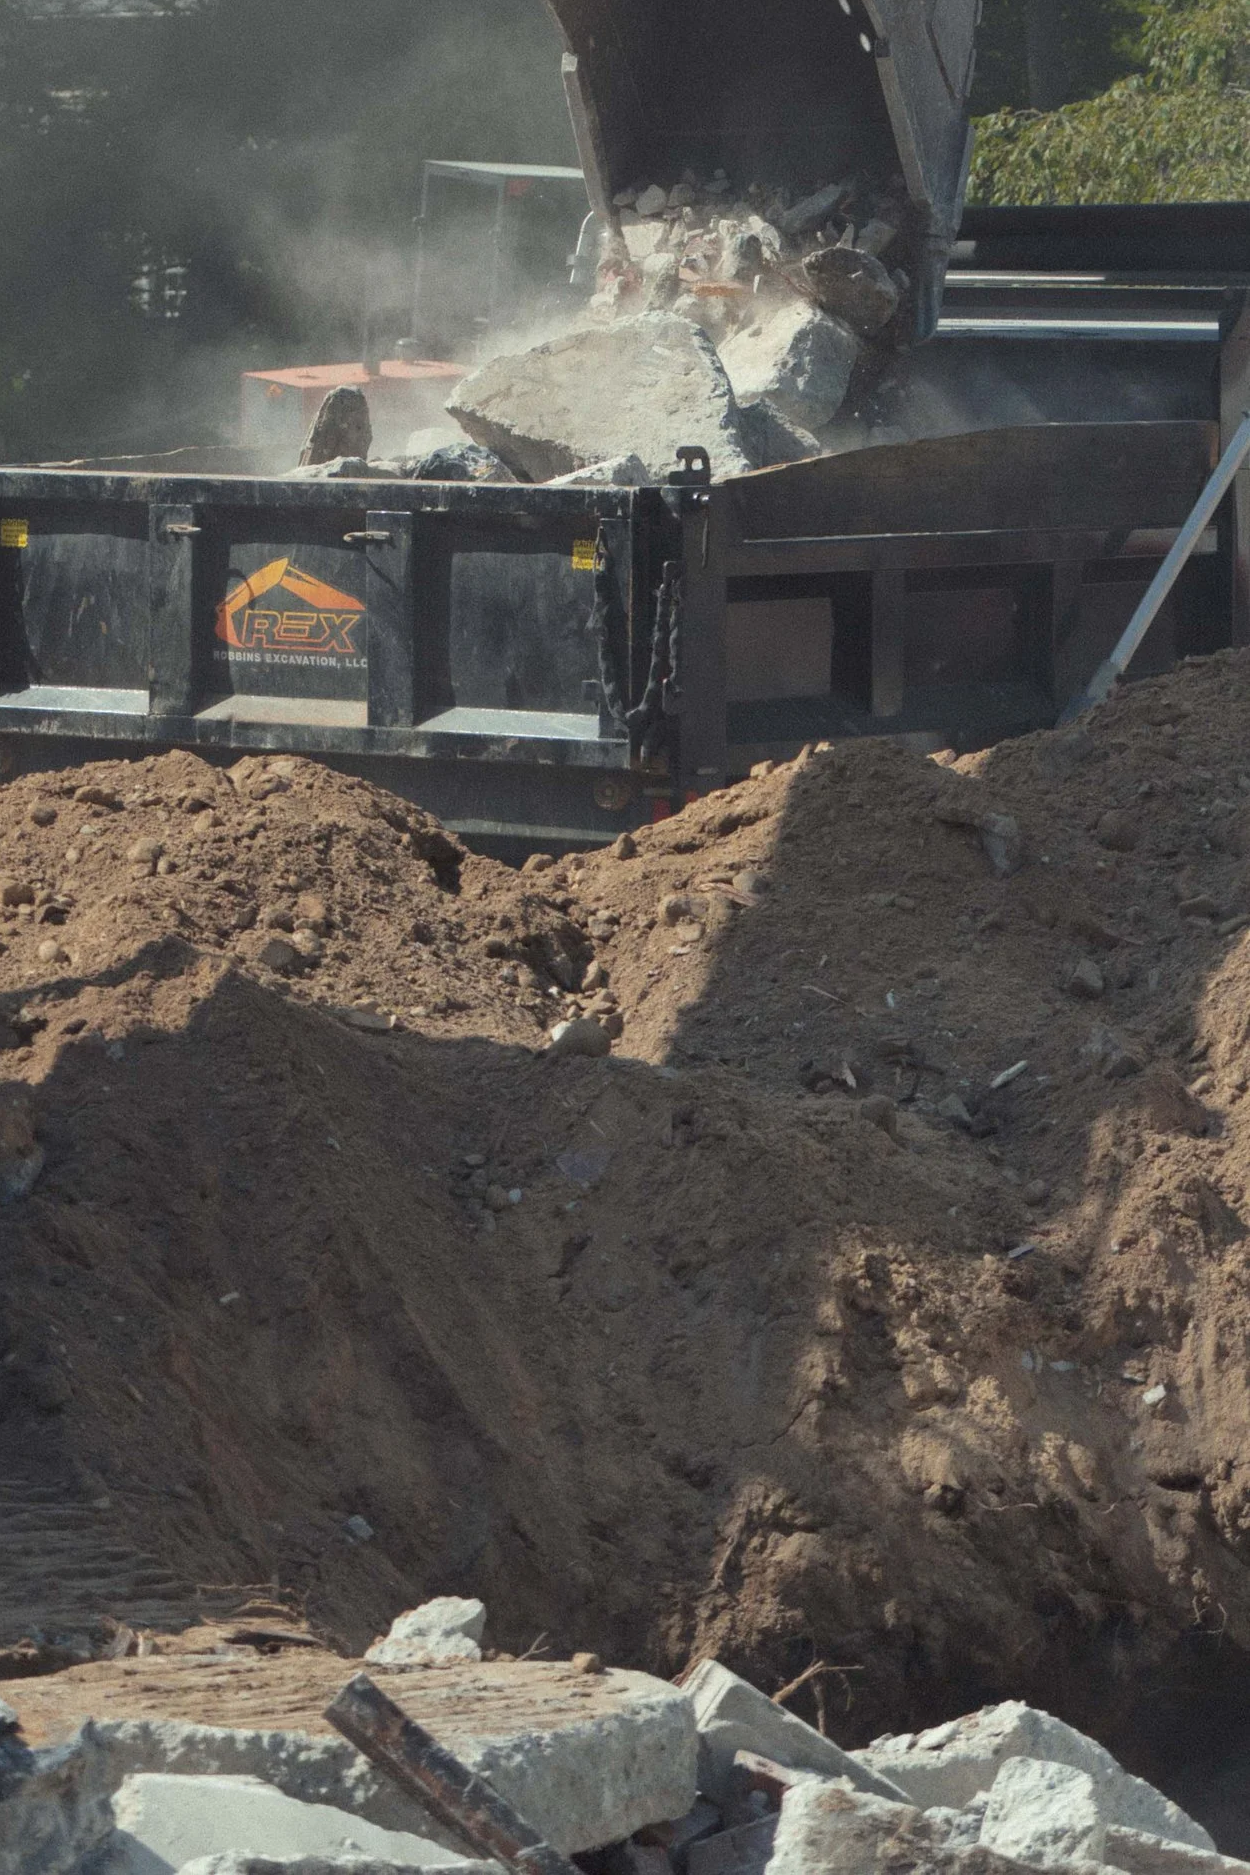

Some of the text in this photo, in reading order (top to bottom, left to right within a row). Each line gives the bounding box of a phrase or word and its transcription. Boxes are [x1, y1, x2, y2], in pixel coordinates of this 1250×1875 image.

[241, 610, 361, 653] REX
[213, 650, 369, 669] ROBBINS EXCAVATION, LLC
